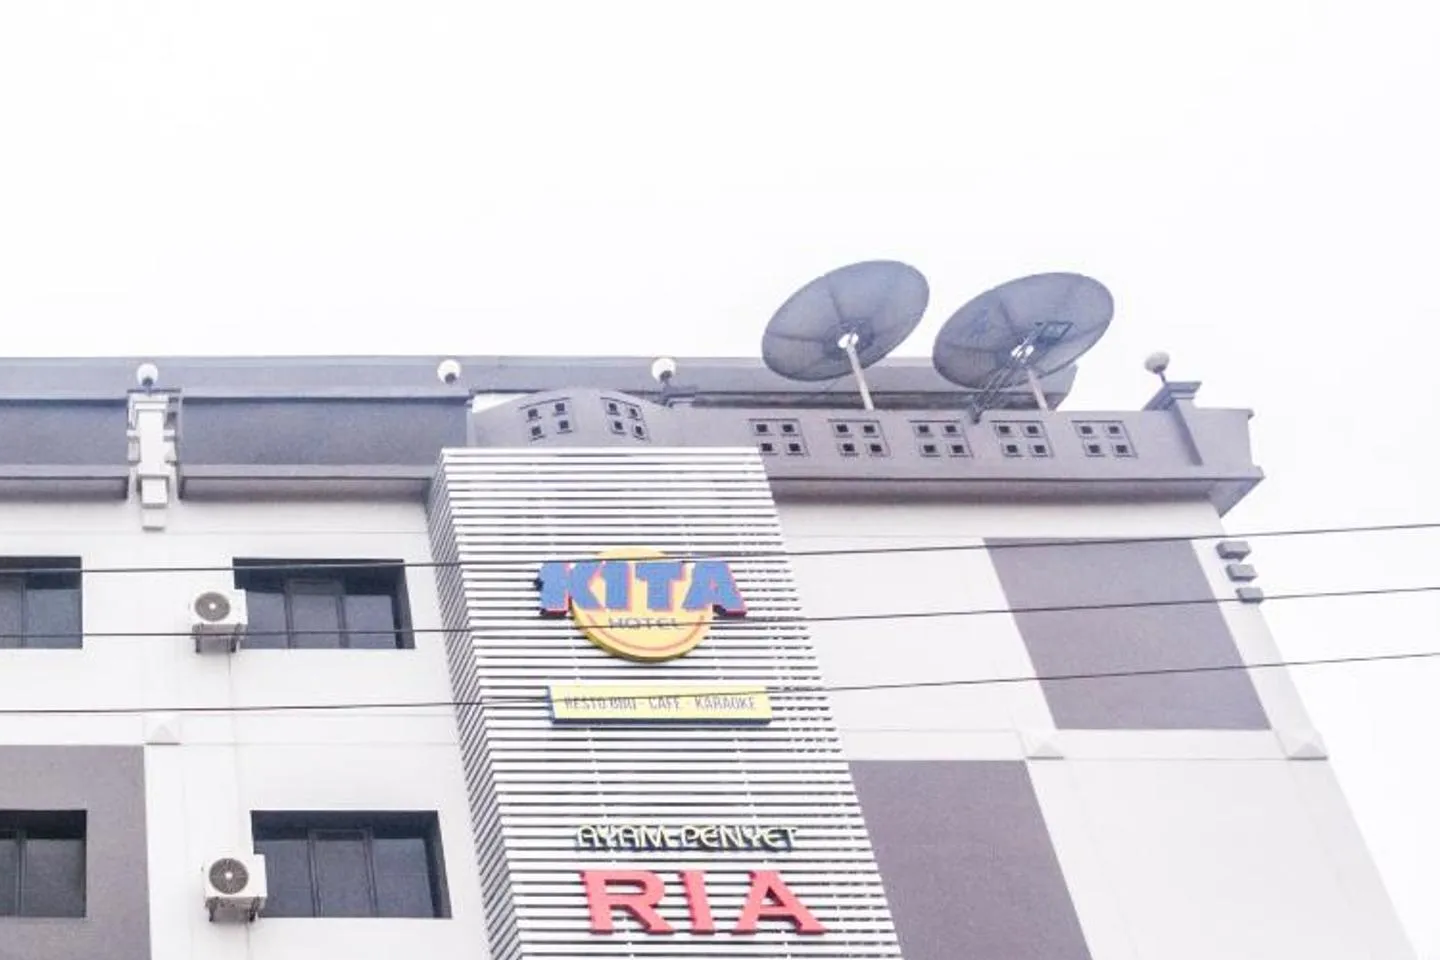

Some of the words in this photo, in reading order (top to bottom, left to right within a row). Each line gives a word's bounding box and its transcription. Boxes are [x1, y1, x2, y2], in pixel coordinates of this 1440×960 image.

[535, 560, 748, 617] KITA
[608, 616, 685, 630] HOTEL
[575, 823, 678, 852] AYAM
[679, 825, 798, 852] PENYET
[579, 869, 828, 935] RIA
